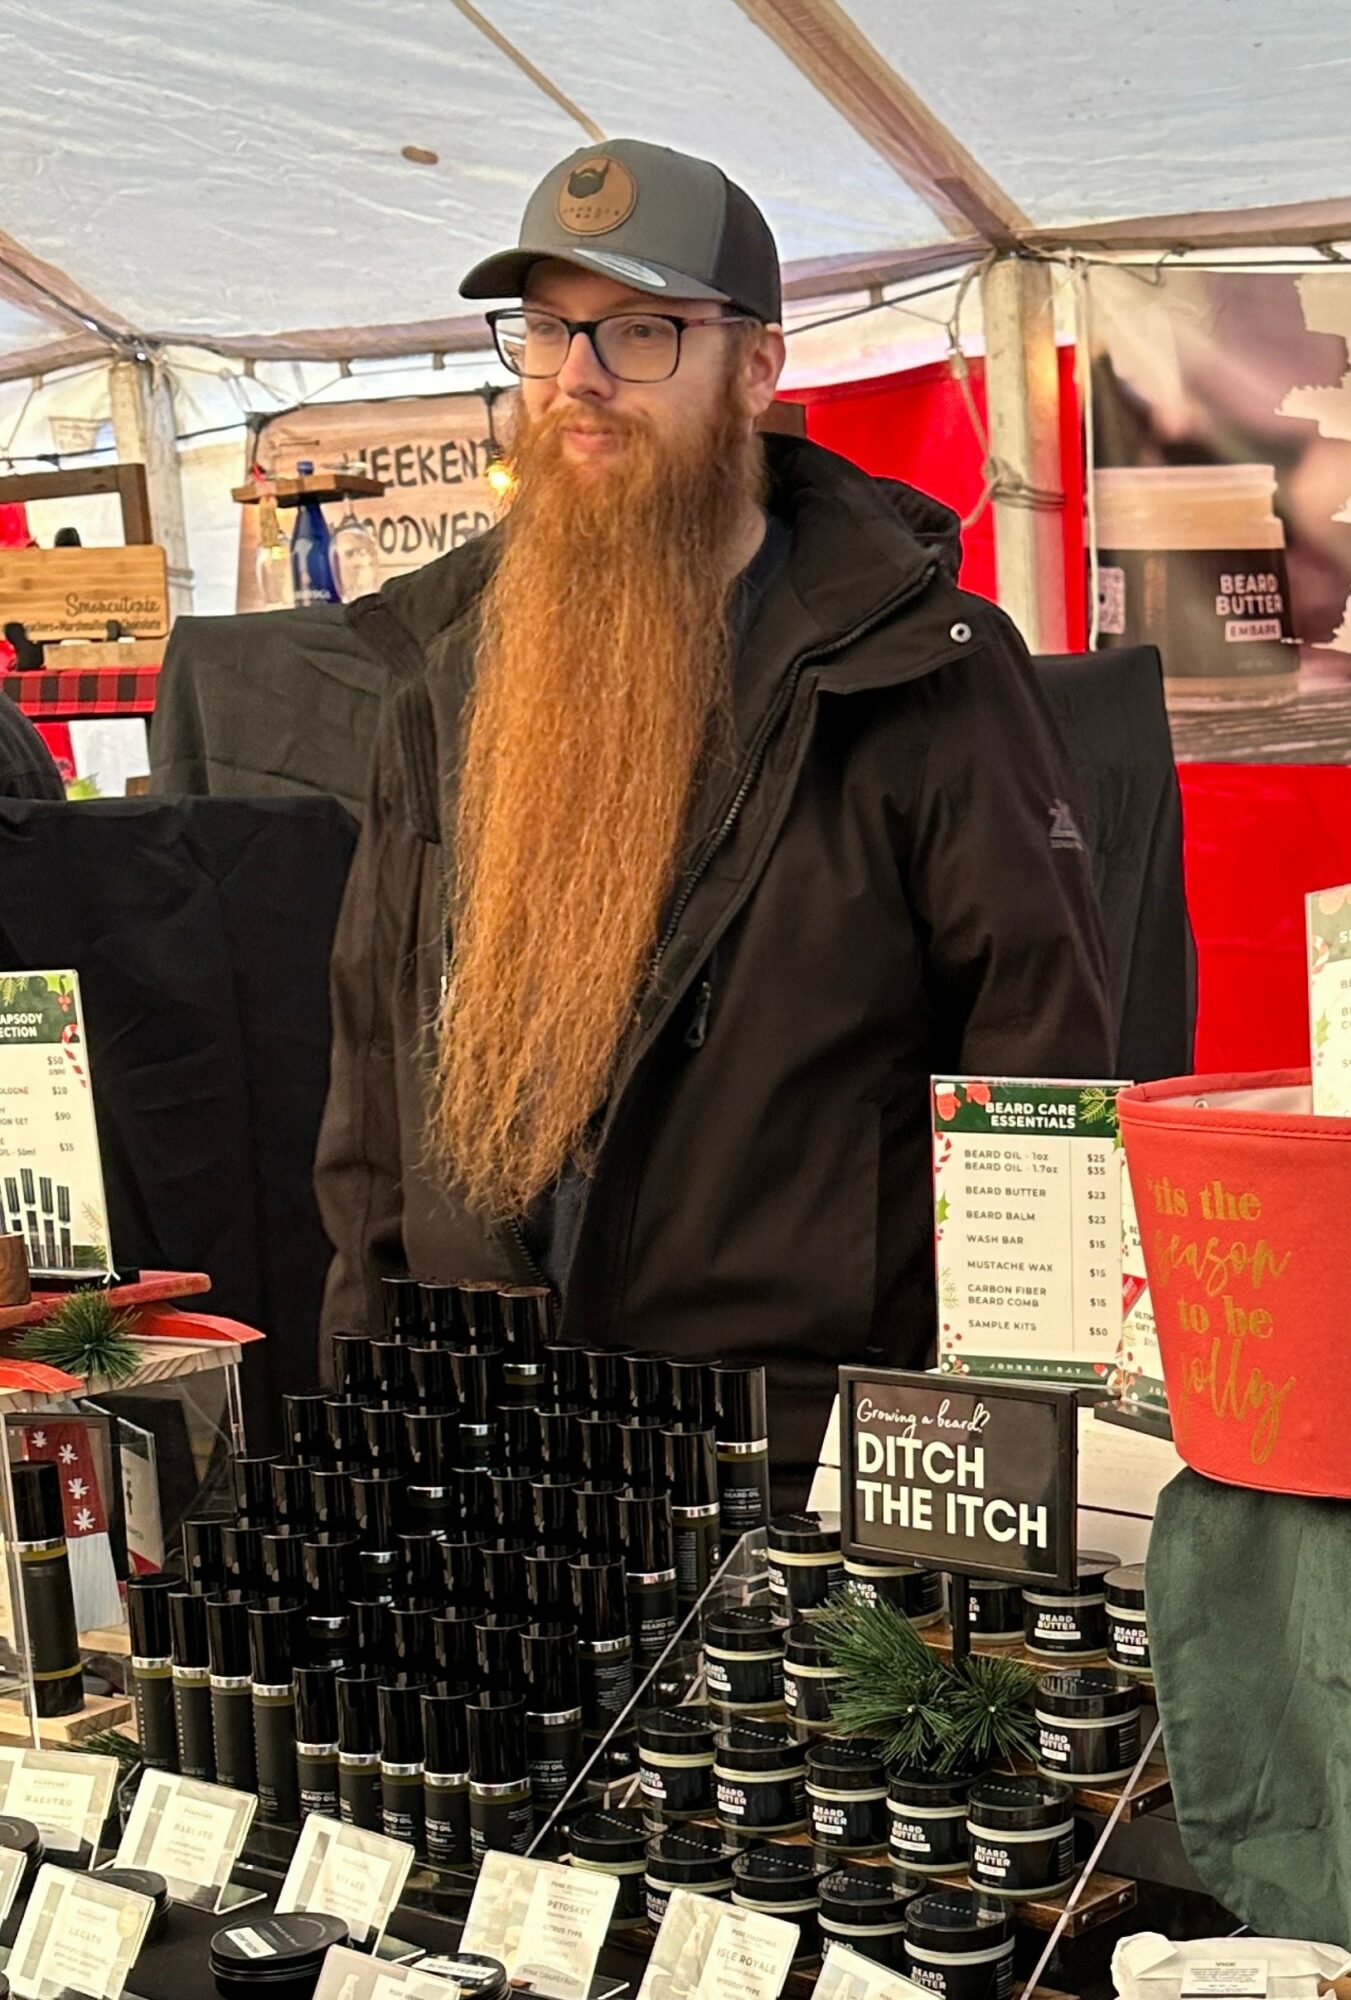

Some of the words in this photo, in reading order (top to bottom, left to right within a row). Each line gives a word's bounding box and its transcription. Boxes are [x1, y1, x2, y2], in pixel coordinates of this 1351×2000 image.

[1220, 573, 1278, 594] BEARD
[1215, 595, 1283, 616] BUTTER
[1230, 624, 1277, 637] EMBARK
[985, 1102, 1034, 1115] BEARD
[1038, 1104, 1077, 1116] CARE
[990, 1115, 1076, 1129] ESSENTIALS
[60, 1142, 74, 1152] $35
[964, 1150, 1001, 1160] BEARD
[1004, 1150, 1022, 1160] OIL
[1087, 1154, 1106, 1163] $25
[965, 1162, 1001, 1171] BEARD
[1004, 1163, 1023, 1172] OIL
[1032, 1164, 1058, 1174] 1.7oz
[1087, 1166, 1106, 1176] $35
[965, 1186, 1002, 1196] BEARD
[1005, 1187, 1047, 1197] BUTTER
[1087, 1190, 1106, 1200] $23
[1199, 1180, 1262, 1220] the
[966, 1210, 1002, 1220] BEARD
[1006, 1211, 1035, 1221] BALM
[1087, 1215, 1106, 1225] $23
[966, 1234, 999, 1244] WASH
[1002, 1235, 1024, 1245] BAR
[1089, 1239, 1106, 1249] $15
[967, 1260, 1025, 1271] MUSTACHE
[1028, 1263, 1053, 1272] WAX
[1089, 1268, 1106, 1278] $15
[967, 1284, 1012, 1294] CARBON
[1015, 1286, 1047, 1296] FIBER
[968, 1296, 1004, 1306] BEARD
[1007, 1297, 1039, 1307] COMB
[1090, 1298, 1107, 1308] $15
[1178, 1294, 1209, 1335] to
[1221, 1294, 1273, 1338] be
[968, 1319, 1010, 1330] SAMPLE
[1013, 1321, 1037, 1331] KITS
[1089, 1327, 1108, 1337] $50
[1176, 1337, 1296, 1465] jolly
[857, 1398, 917, 1439] Growing
[921, 1415, 934, 1425] a
[937, 1398, 991, 1434] beard?
[858, 1431, 985, 1489] DITCH
[856, 1480, 932, 1531] THE
[946, 1493, 1047, 1548] ITCH
[1038, 1620, 1076, 1631] BUTTER
[1039, 1613, 1074, 1623] BEARD
[1115, 1625, 1147, 1639] BEARD
[1113, 1633, 1149, 1647] BUTTER
[1040, 1729, 1068, 1744] BEARD
[1039, 1737, 1071, 1752] BUTTER
[717, 1784, 745, 1798] BEARD
[717, 1790, 747, 1806] BUTTER
[812, 1811, 848, 1826] BUTTER
[813, 1804, 845, 1818] BEARD
[892, 1827, 926, 1842] BUTTER
[893, 1820, 923, 1834] BEARD
[975, 1844, 1009, 1859] BEARD
[974, 1851, 1011, 1868] BUTTER
[717, 1947, 738, 1962] ISLE
[739, 1954, 777, 1976] ROYALE
[912, 1965, 944, 1982] BEARD
